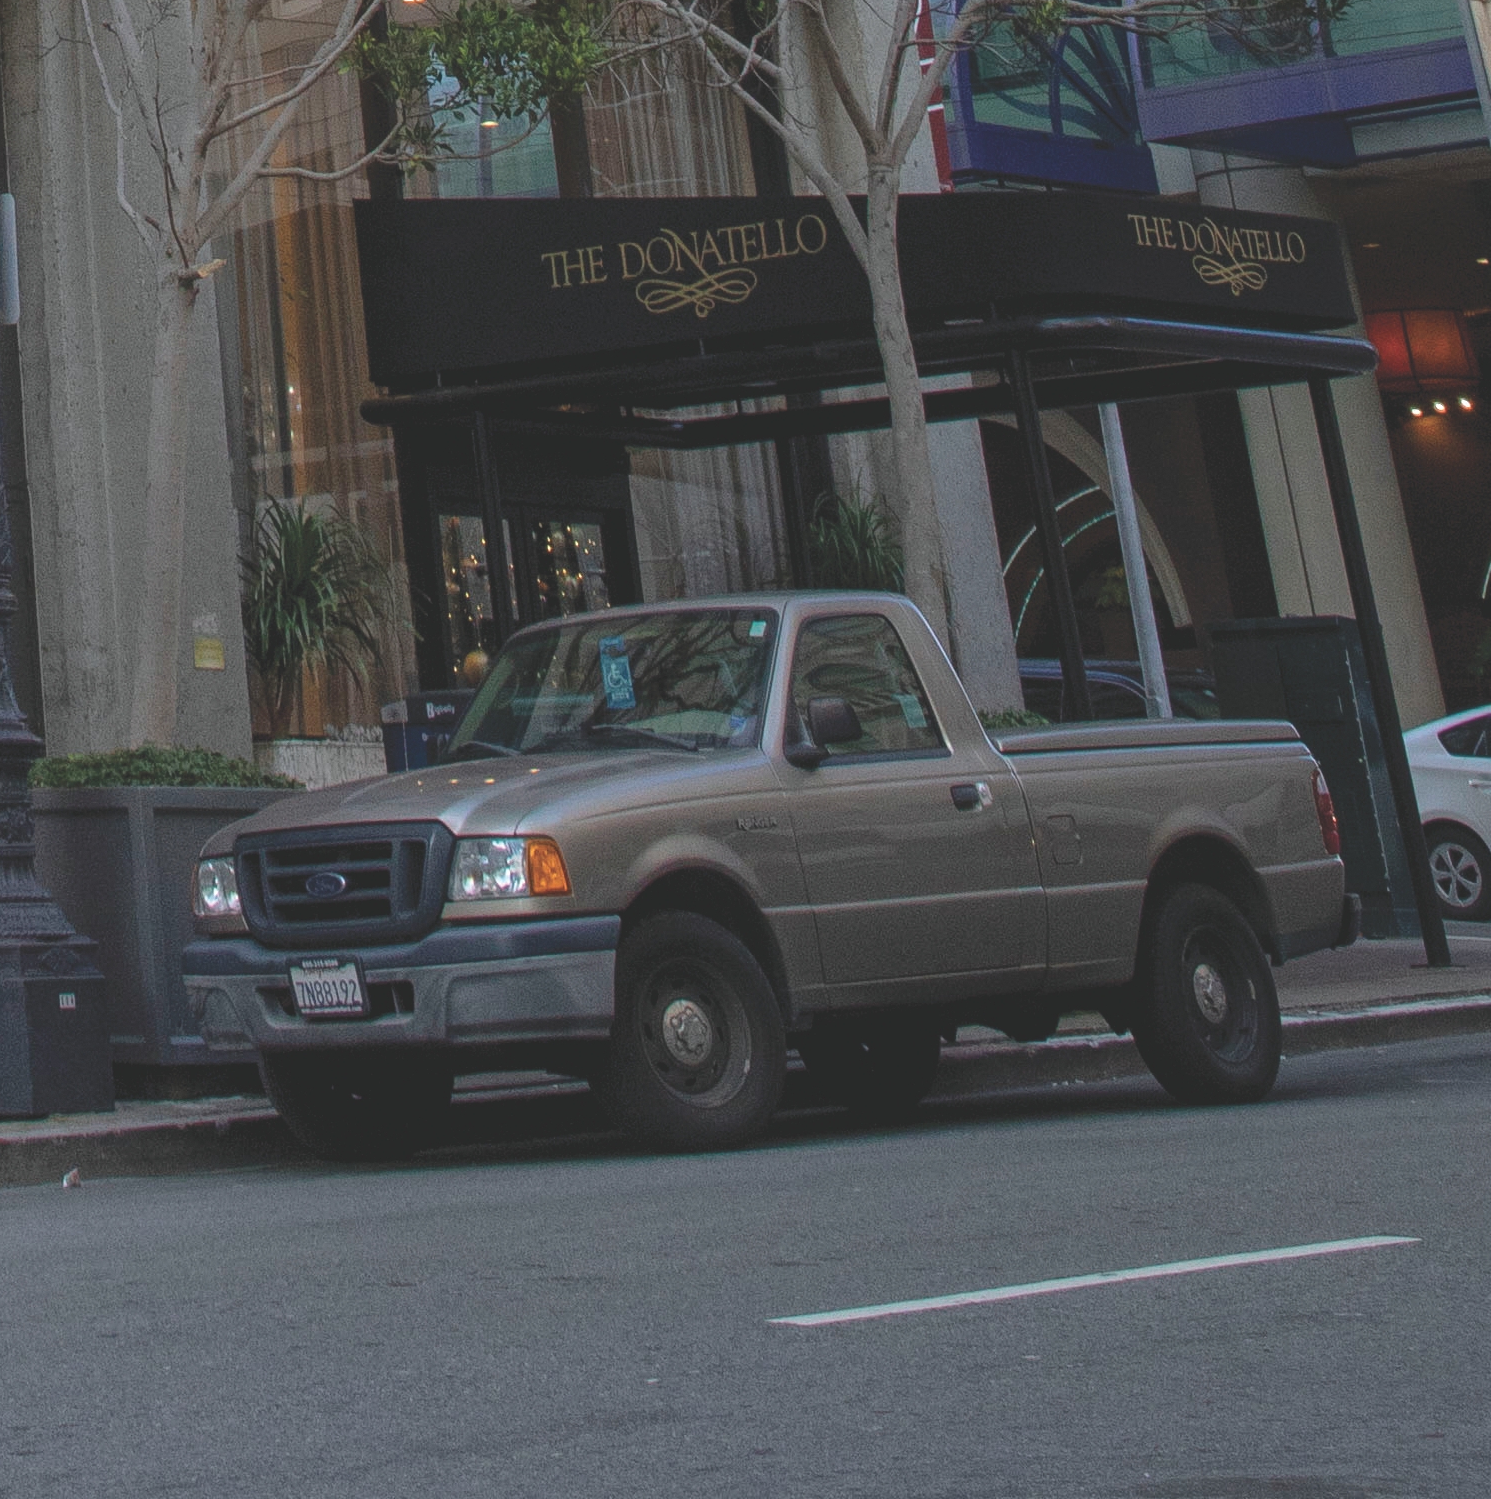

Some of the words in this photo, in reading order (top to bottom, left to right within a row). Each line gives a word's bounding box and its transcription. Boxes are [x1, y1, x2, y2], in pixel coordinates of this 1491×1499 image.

[541, 246, 608, 289] THE
[620, 214, 826, 281] DONATELLO
[1128, 214, 1177, 249] THE
[1179, 217, 1305, 264] DONATELLO
[296, 979, 362, 1008] 7N88192
